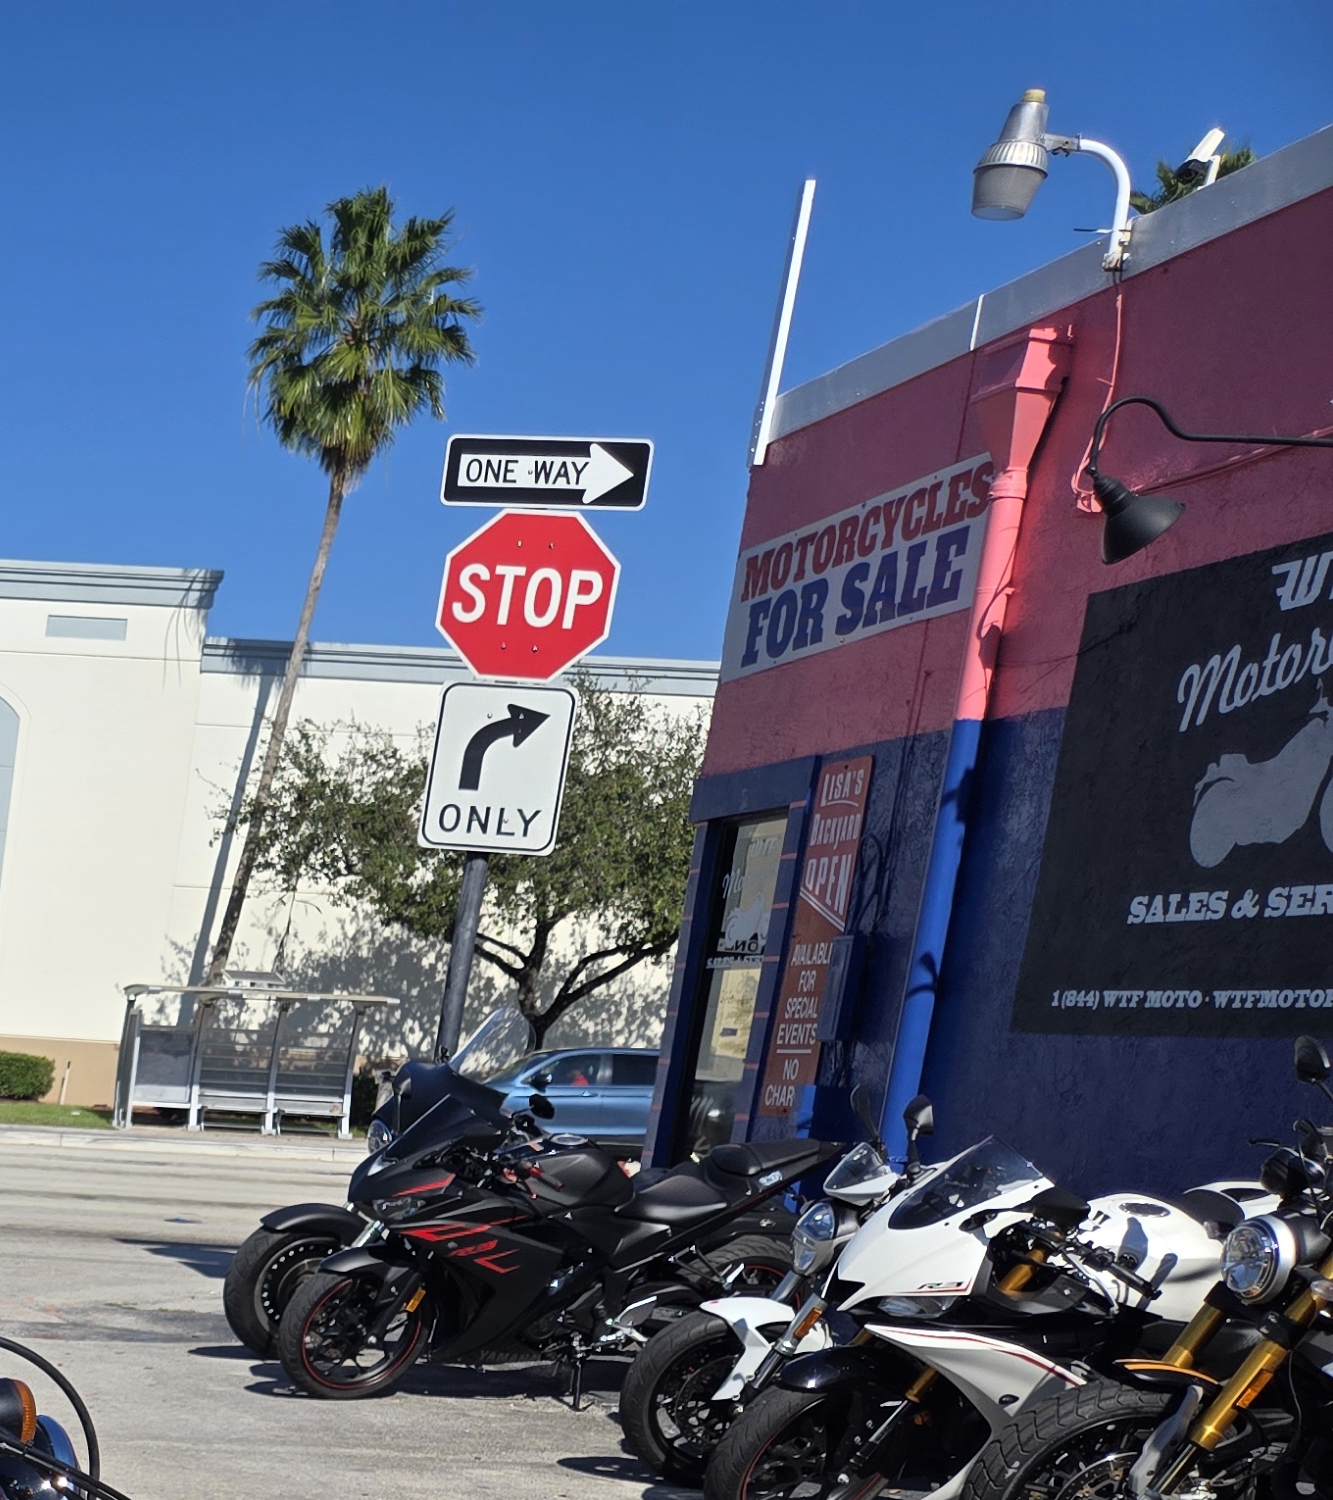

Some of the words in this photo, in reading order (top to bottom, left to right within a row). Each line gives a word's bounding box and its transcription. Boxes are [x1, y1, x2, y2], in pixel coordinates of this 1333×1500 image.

[465, 458, 519, 484] ONE
[534, 460, 590, 486] WAY
[741, 461, 994, 603] MOTORCYCLES
[451, 562, 604, 631] STOP
[740, 577, 830, 669] FOR
[834, 524, 971, 636] SALE
[1177, 626, 1333, 733] Motor
[820, 768, 865, 807] LISA'S
[438, 802, 543, 838] ONLY
[805, 852, 852, 916] OPEN
[1126, 890, 1229, 925] SALES
[1231, 888, 1260, 920] &
[798, 970, 817, 993] FOR
[1103, 990, 1144, 1008] WTF
[1144, 990, 1203, 1009] MOTO
[784, 997, 819, 1019] SPECIAL
[776, 1022, 818, 1046] EVENTS
[782, 1058, 800, 1081] NO
[764, 1084, 795, 1108] CHAR
